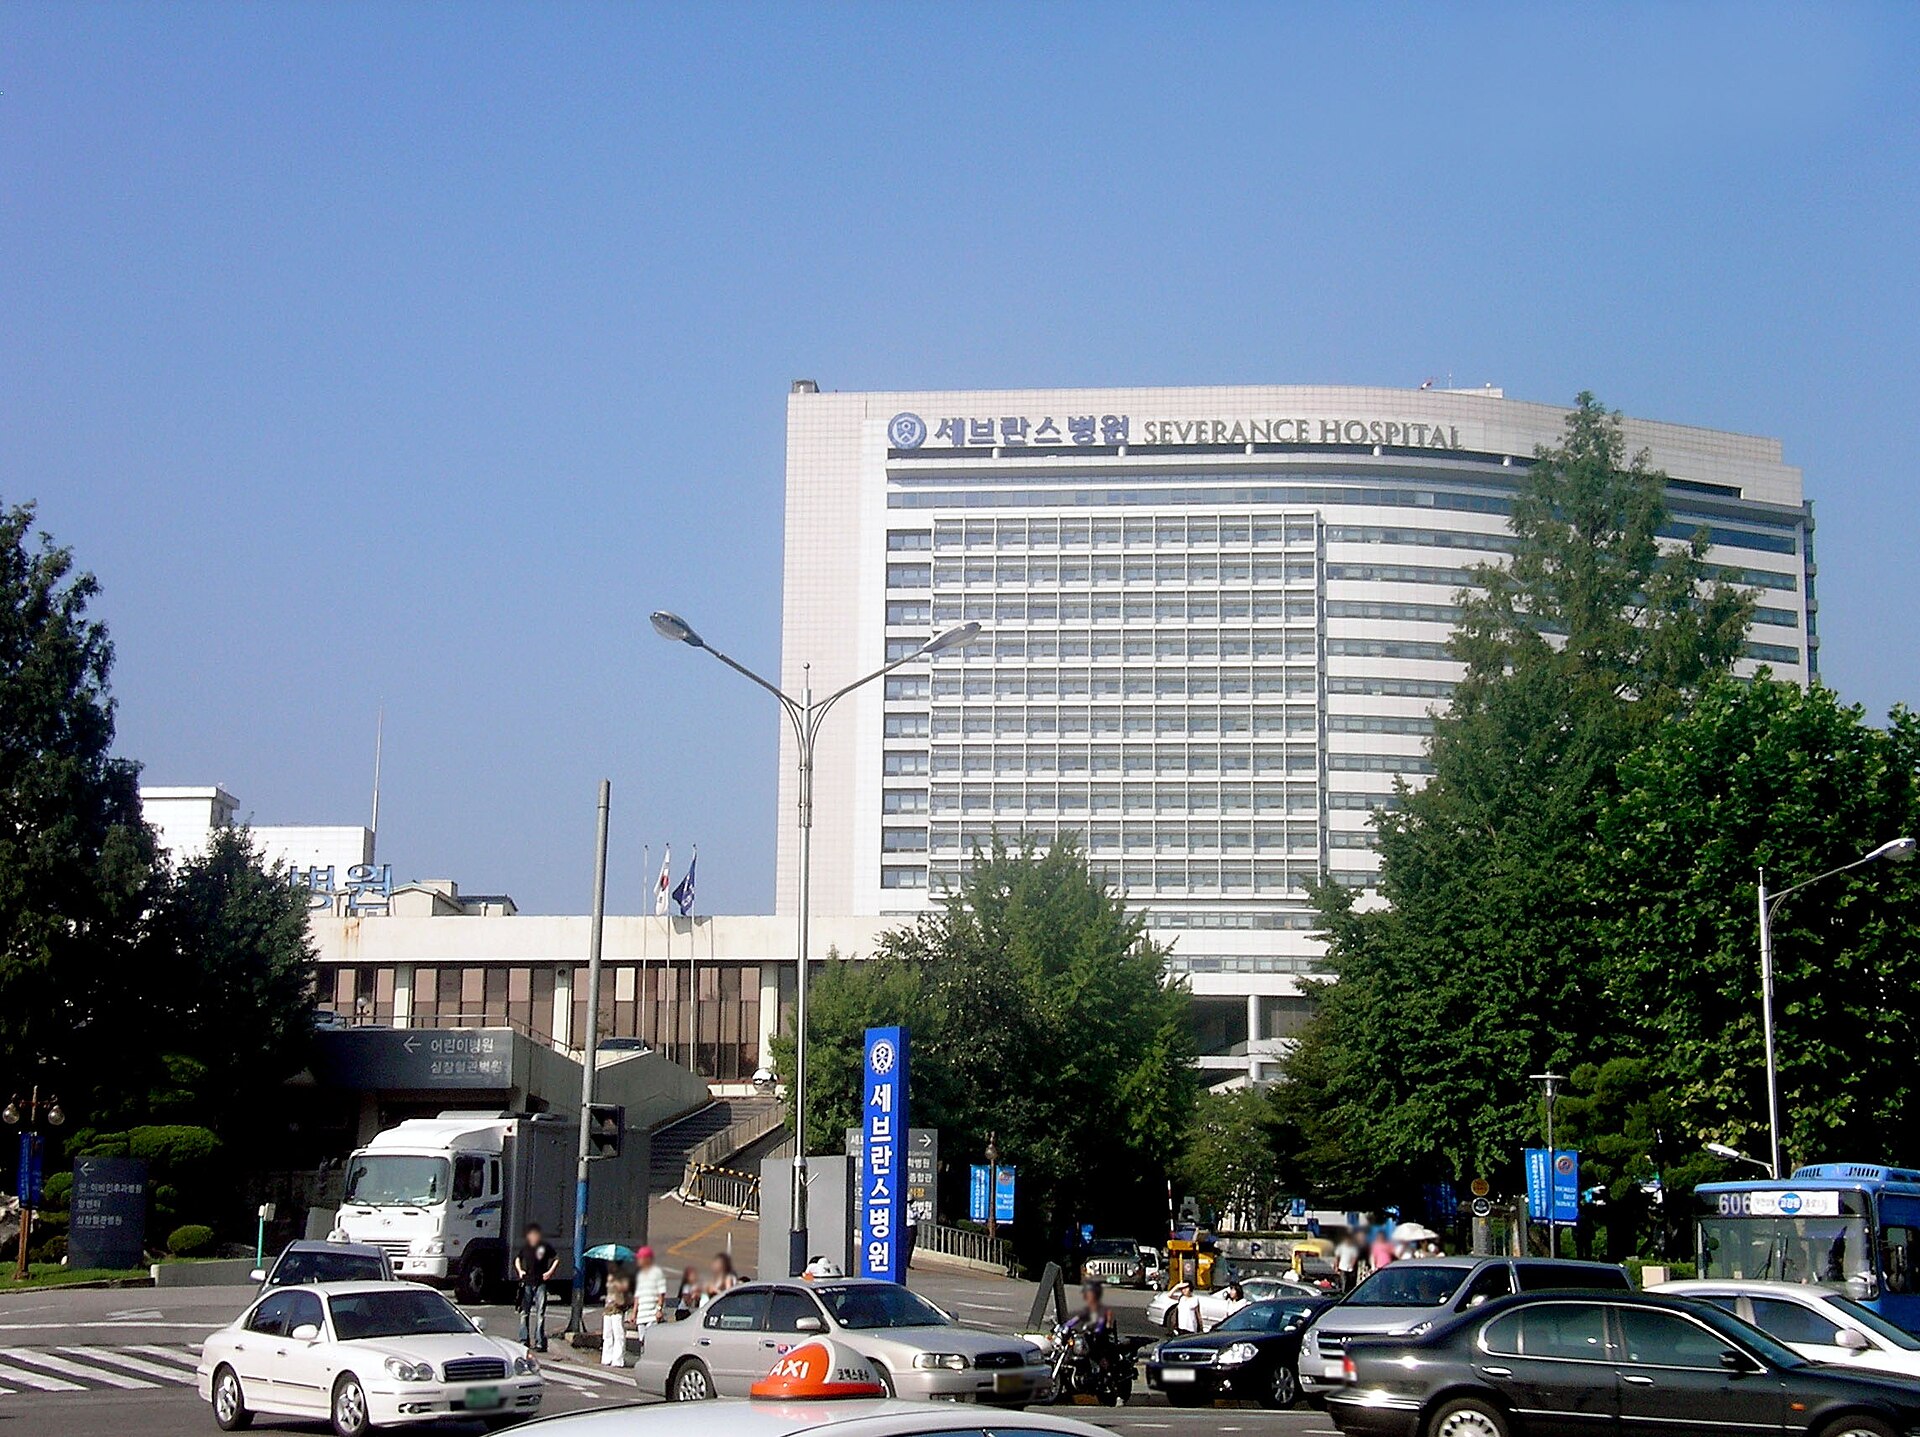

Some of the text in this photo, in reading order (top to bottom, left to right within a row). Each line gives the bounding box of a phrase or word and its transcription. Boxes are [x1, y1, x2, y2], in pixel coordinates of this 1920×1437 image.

[935, 415, 1129, 446] 세브란스병원
[1144, 418, 1464, 450] SEVERANCE HOSPITAL
[430, 1038, 494, 1054] 어린이병원
[868, 1083, 893, 1272] 세브란스병원
[769, 1359, 809, 1379] AXI
